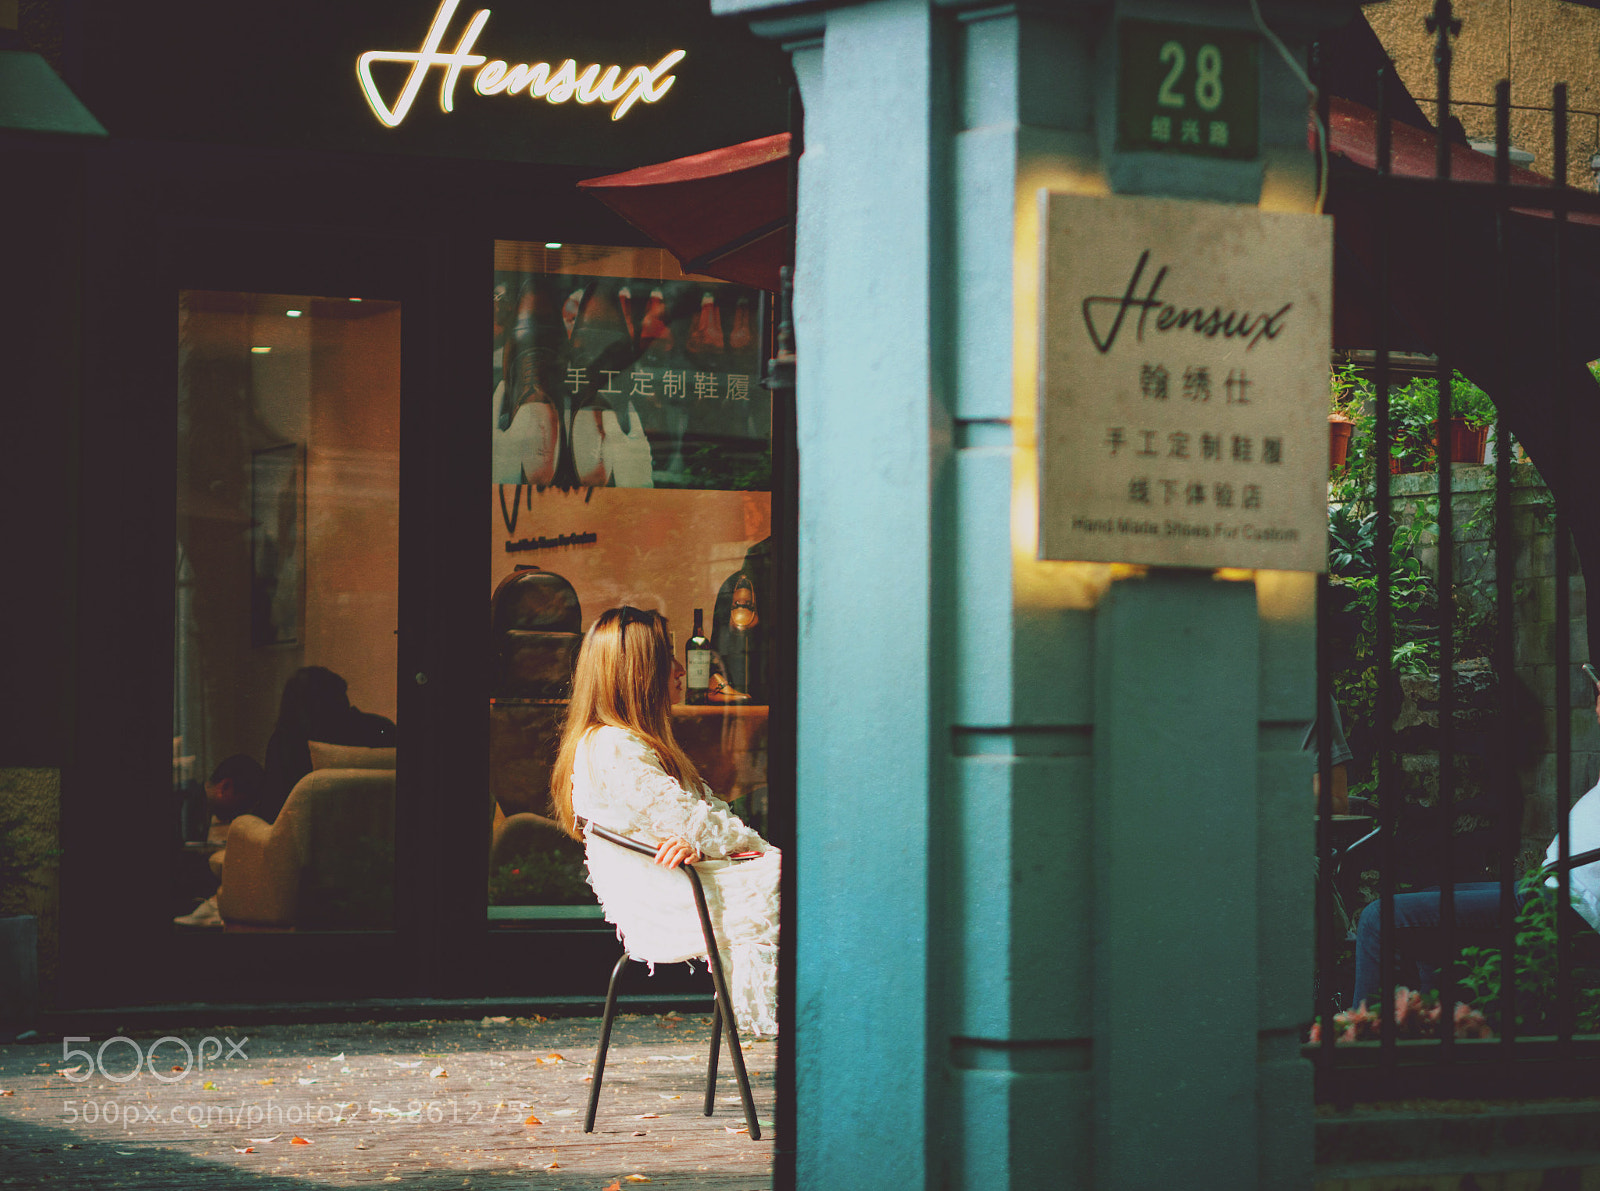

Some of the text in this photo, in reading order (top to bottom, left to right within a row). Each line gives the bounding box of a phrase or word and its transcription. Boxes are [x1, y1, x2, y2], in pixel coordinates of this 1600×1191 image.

[357, 0, 686, 127] Hensux
[1158, 41, 1223, 111] 28
[1083, 250, 1292, 353] Hensux
[564, 368, 750, 401] 手工定制鞋履
[1106, 427, 1283, 464] 手工定制鞋履
[1129, 477, 1262, 508] 线下体验店
